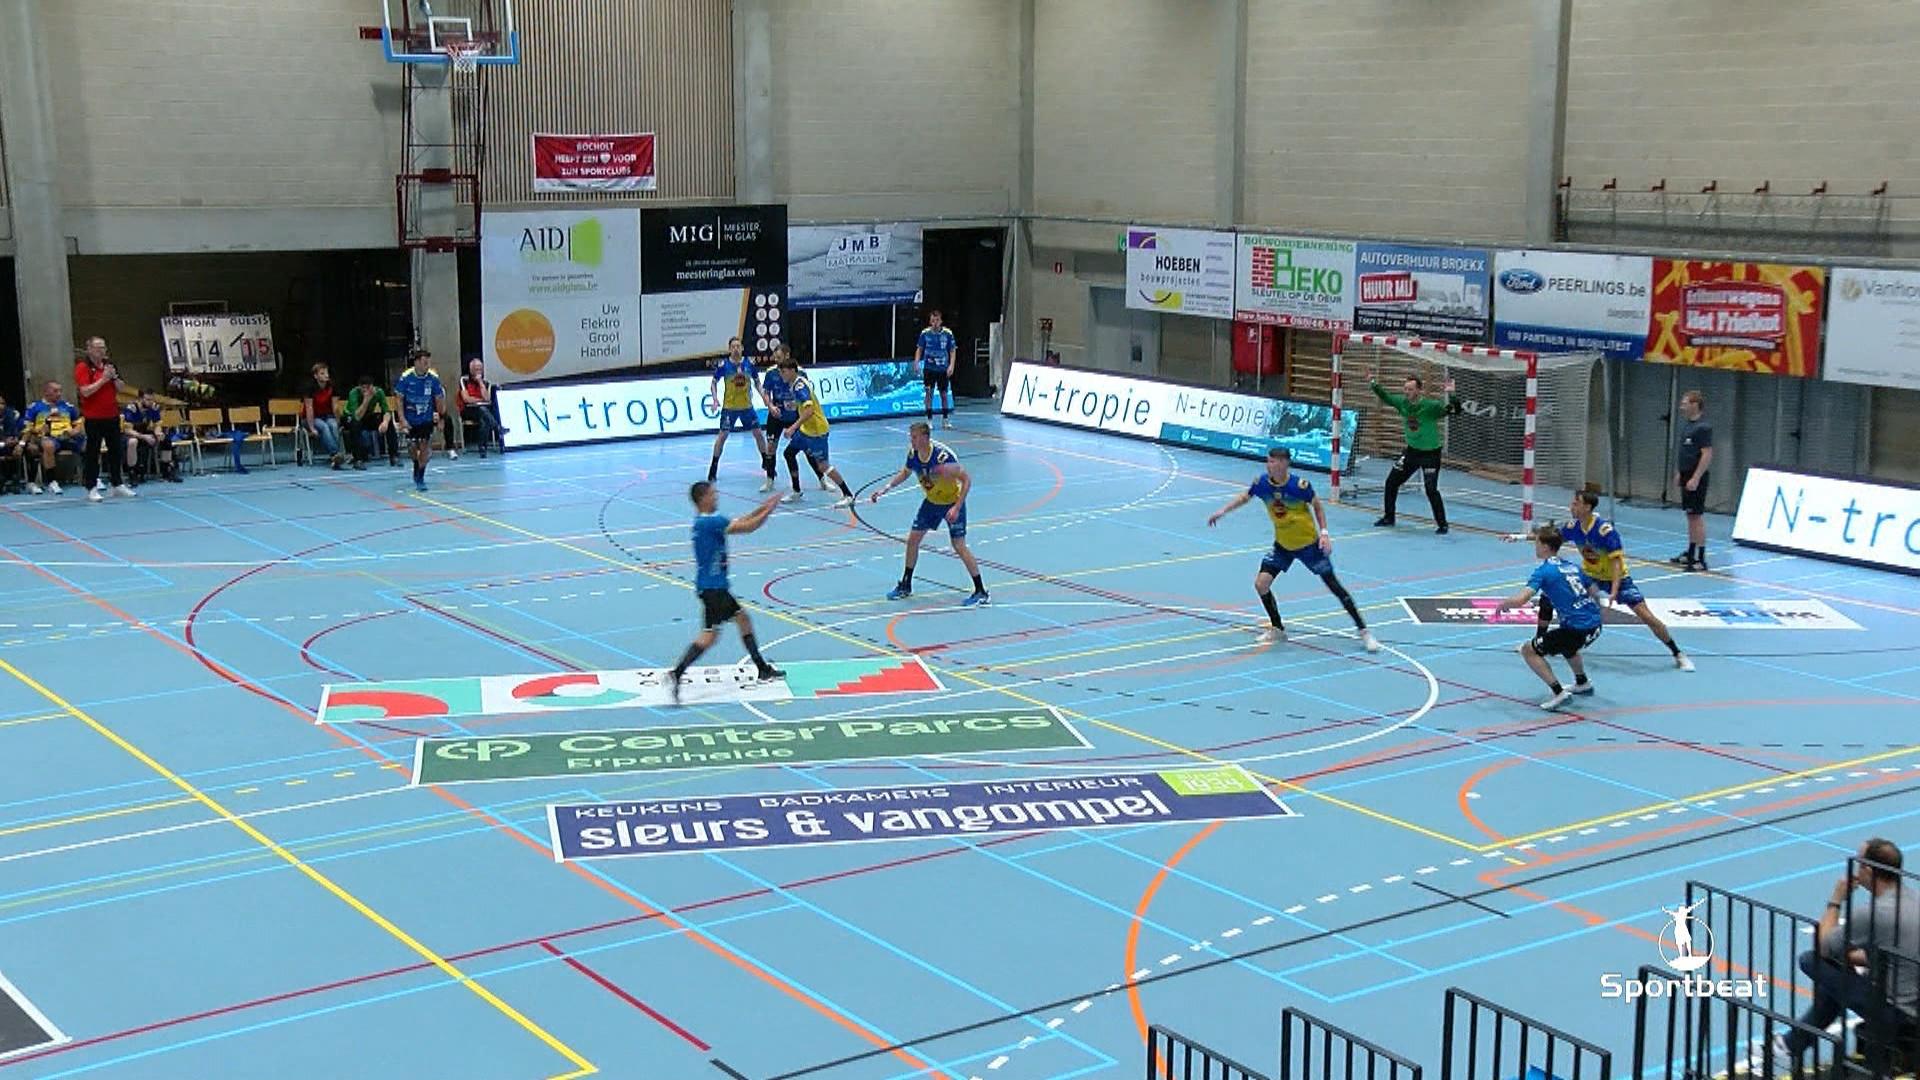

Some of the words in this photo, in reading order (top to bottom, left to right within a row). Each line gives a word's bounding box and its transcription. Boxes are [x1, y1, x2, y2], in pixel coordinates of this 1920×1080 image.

[576, 142, 615, 151] BOCHOLT
[555, 154, 580, 163] HEEFT
[582, 154, 598, 163] EEN
[612, 153, 637, 162] VOOR
[580, 166, 631, 175] SPORTCLUBS
[520, 226, 564, 251] AID
[669, 224, 713, 243] MIG
[724, 232, 733, 241] IN
[735, 231, 757, 241] GLAS
[1244, 236, 1354, 253] BOUWONDERNEMING
[1155, 255, 1200, 273] HOEBEN
[1360, 251, 1441, 269] AUTOVERHUUR
[1441, 258, 1485, 272] BROEKX
[676, 268, 756, 280] meesteringlas.com
[1140, 273, 1200, 287] bouwprojecten
[1273, 248, 1343, 295] BEKO
[1363, 280, 1394, 299] HUUR
[1506, 273, 1536, 290] Ford
[1548, 277, 1646, 297] PEERLINGS.be
[1251, 287, 1287, 299] SLEUTEL
[1288, 291, 1302, 299] OP
[1303, 292, 1316, 301] DE
[1317, 294, 1342, 304] DEUR
[602, 304, 620, 315] Uw
[185, 319, 217, 327] HOME
[230, 317, 269, 325] GUESTS
[581, 318, 620, 329] Elektro
[589, 333, 620, 343] Groot
[1522, 332, 1564, 346] PARTNER
[1565, 335, 1576, 346] IN
[1577, 337, 1632, 352] MOBILITEIT
[580, 345, 621, 357] Handel
[208, 362, 257, 371] TIME-OUT
[1018, 373, 1151, 427] N-tropie
[1175, 391, 1265, 427] N-tropie
[523, 386, 721, 434] N-tropie
[559, 723, 826, 753] Center
[836, 715, 1052, 738] Parcs
[567, 747, 794, 769] Erperheide
[575, 802, 723, 819] KEUKENS
[759, 787, 950, 808] BADKAMERS
[984, 777, 1143, 796] INTERIEUR
[579, 818, 769, 850] sleurs
[785, 810, 831, 836] &
[843, 790, 1171, 832] vangompel
